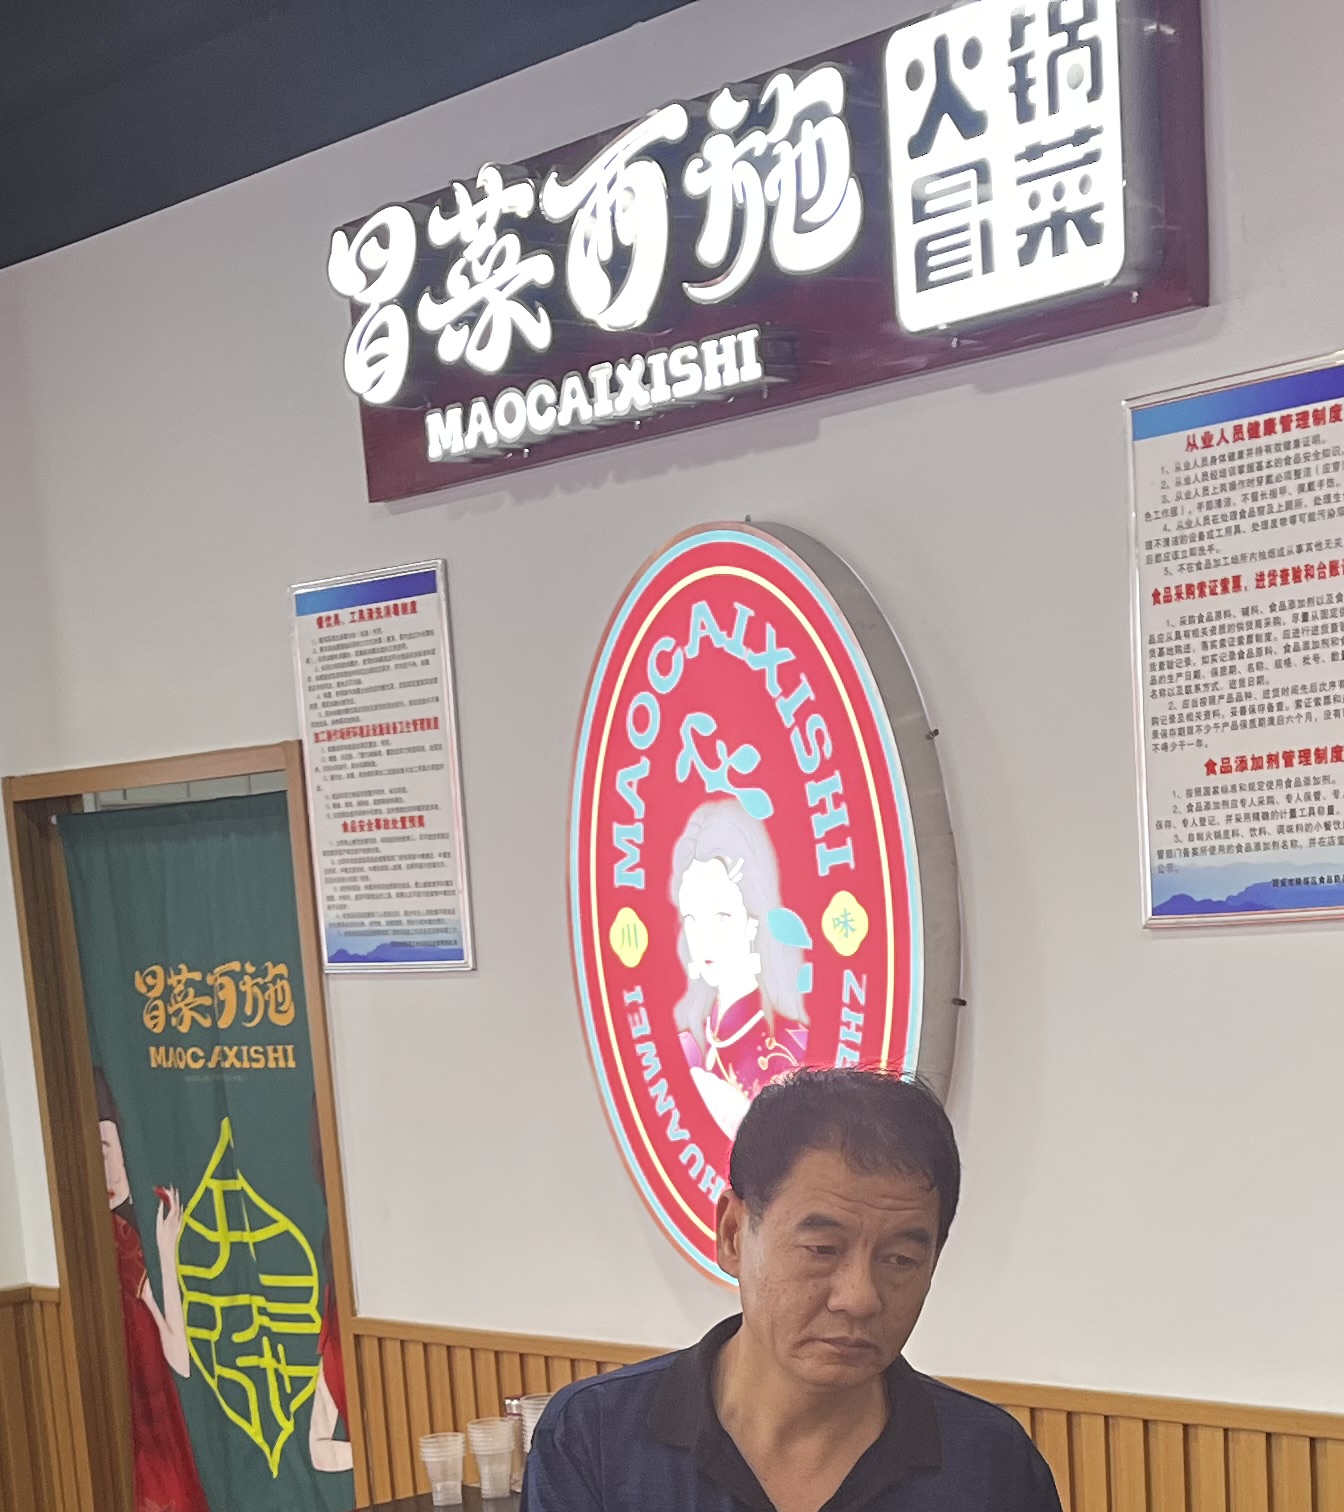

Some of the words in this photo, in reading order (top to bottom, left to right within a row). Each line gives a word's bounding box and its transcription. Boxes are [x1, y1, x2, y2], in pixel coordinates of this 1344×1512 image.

[905, 0, 1104, 160] 火锅
[912, 127, 1106, 294] 冒菜
[425, 327, 764, 462] MAOCAIXISHI
[1183, 401, 1343, 454] 从业人员健康管理制度
[613, 600, 857, 889] MAOCAIXISHI
[1203, 743, 1344, 776] 食品添加剂管理制度
